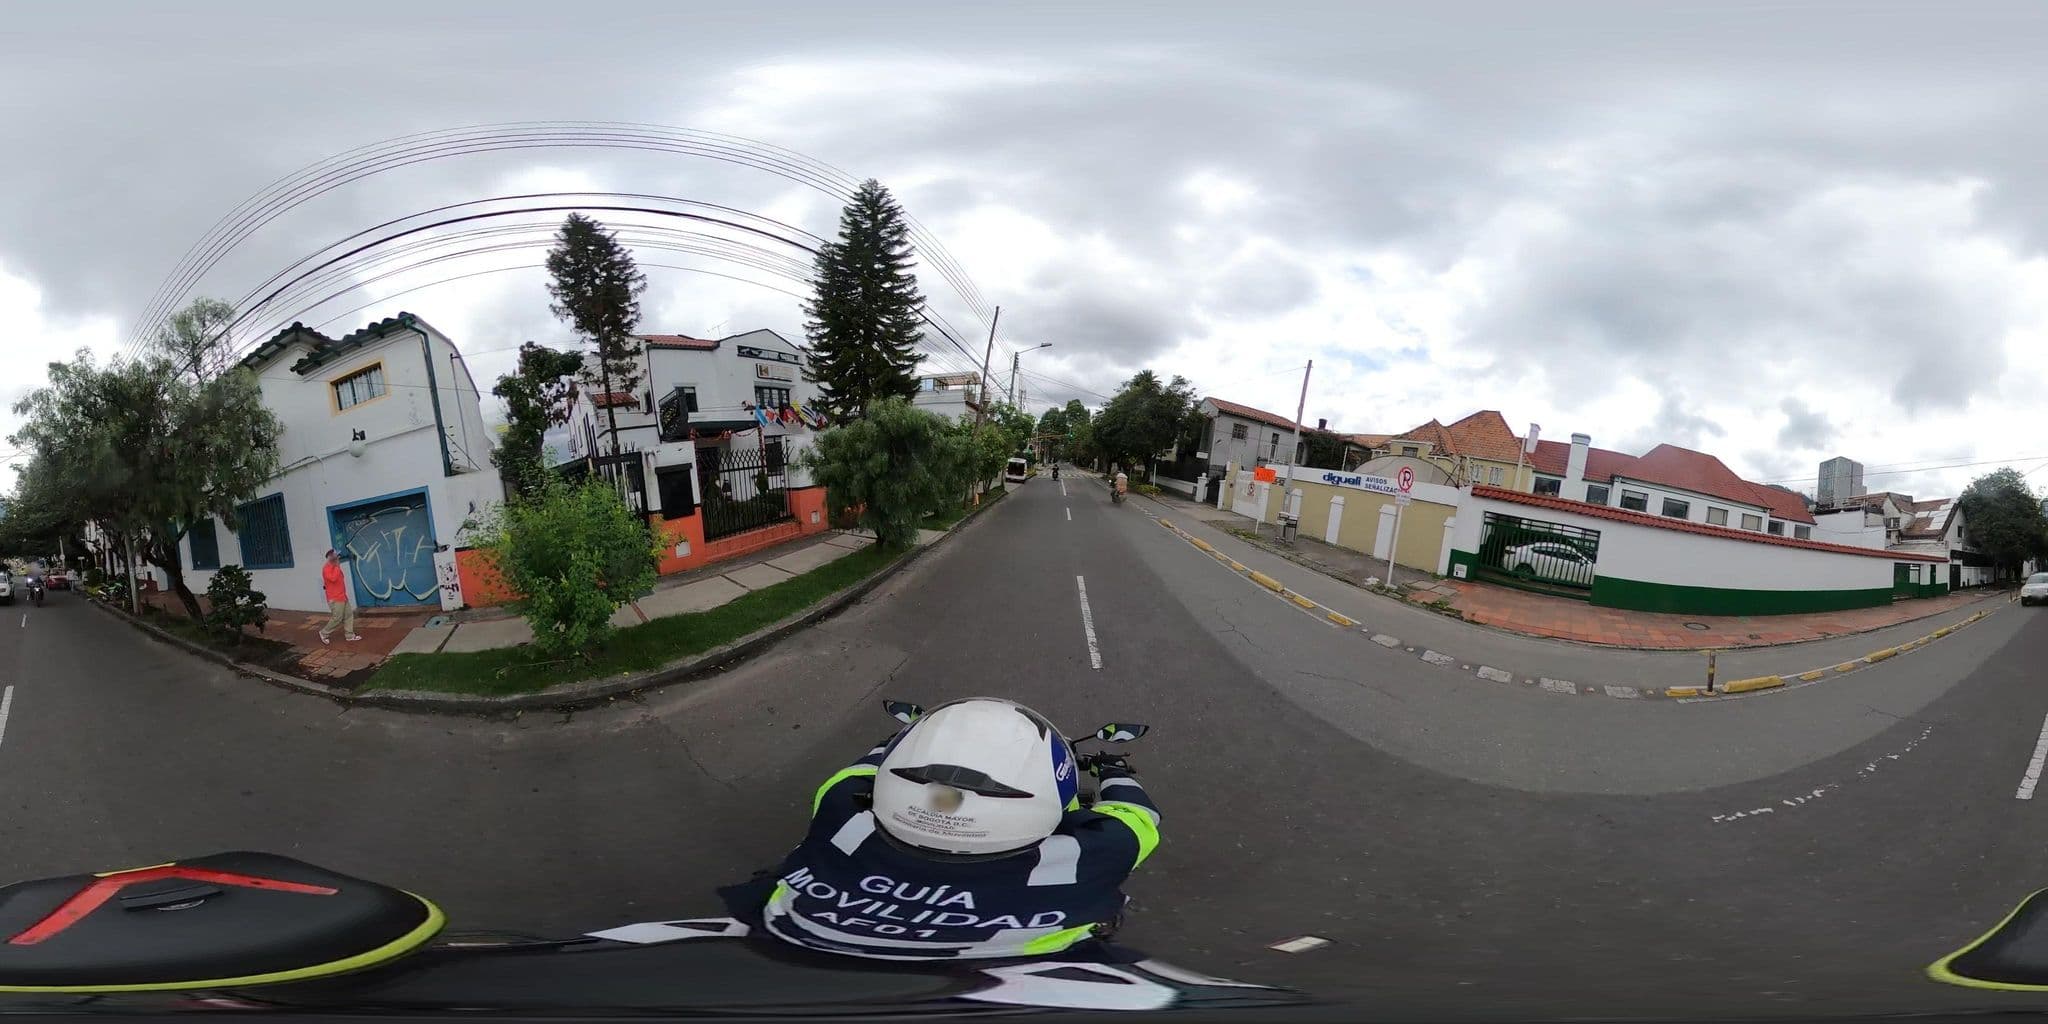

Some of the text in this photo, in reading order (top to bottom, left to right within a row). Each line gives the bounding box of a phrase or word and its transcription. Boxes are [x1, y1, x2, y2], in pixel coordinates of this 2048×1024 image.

[1366, 477, 1388, 485] AVISOS
[784, 866, 1067, 929] MOVILIDAD
[859, 875, 976, 909] GUÍA
